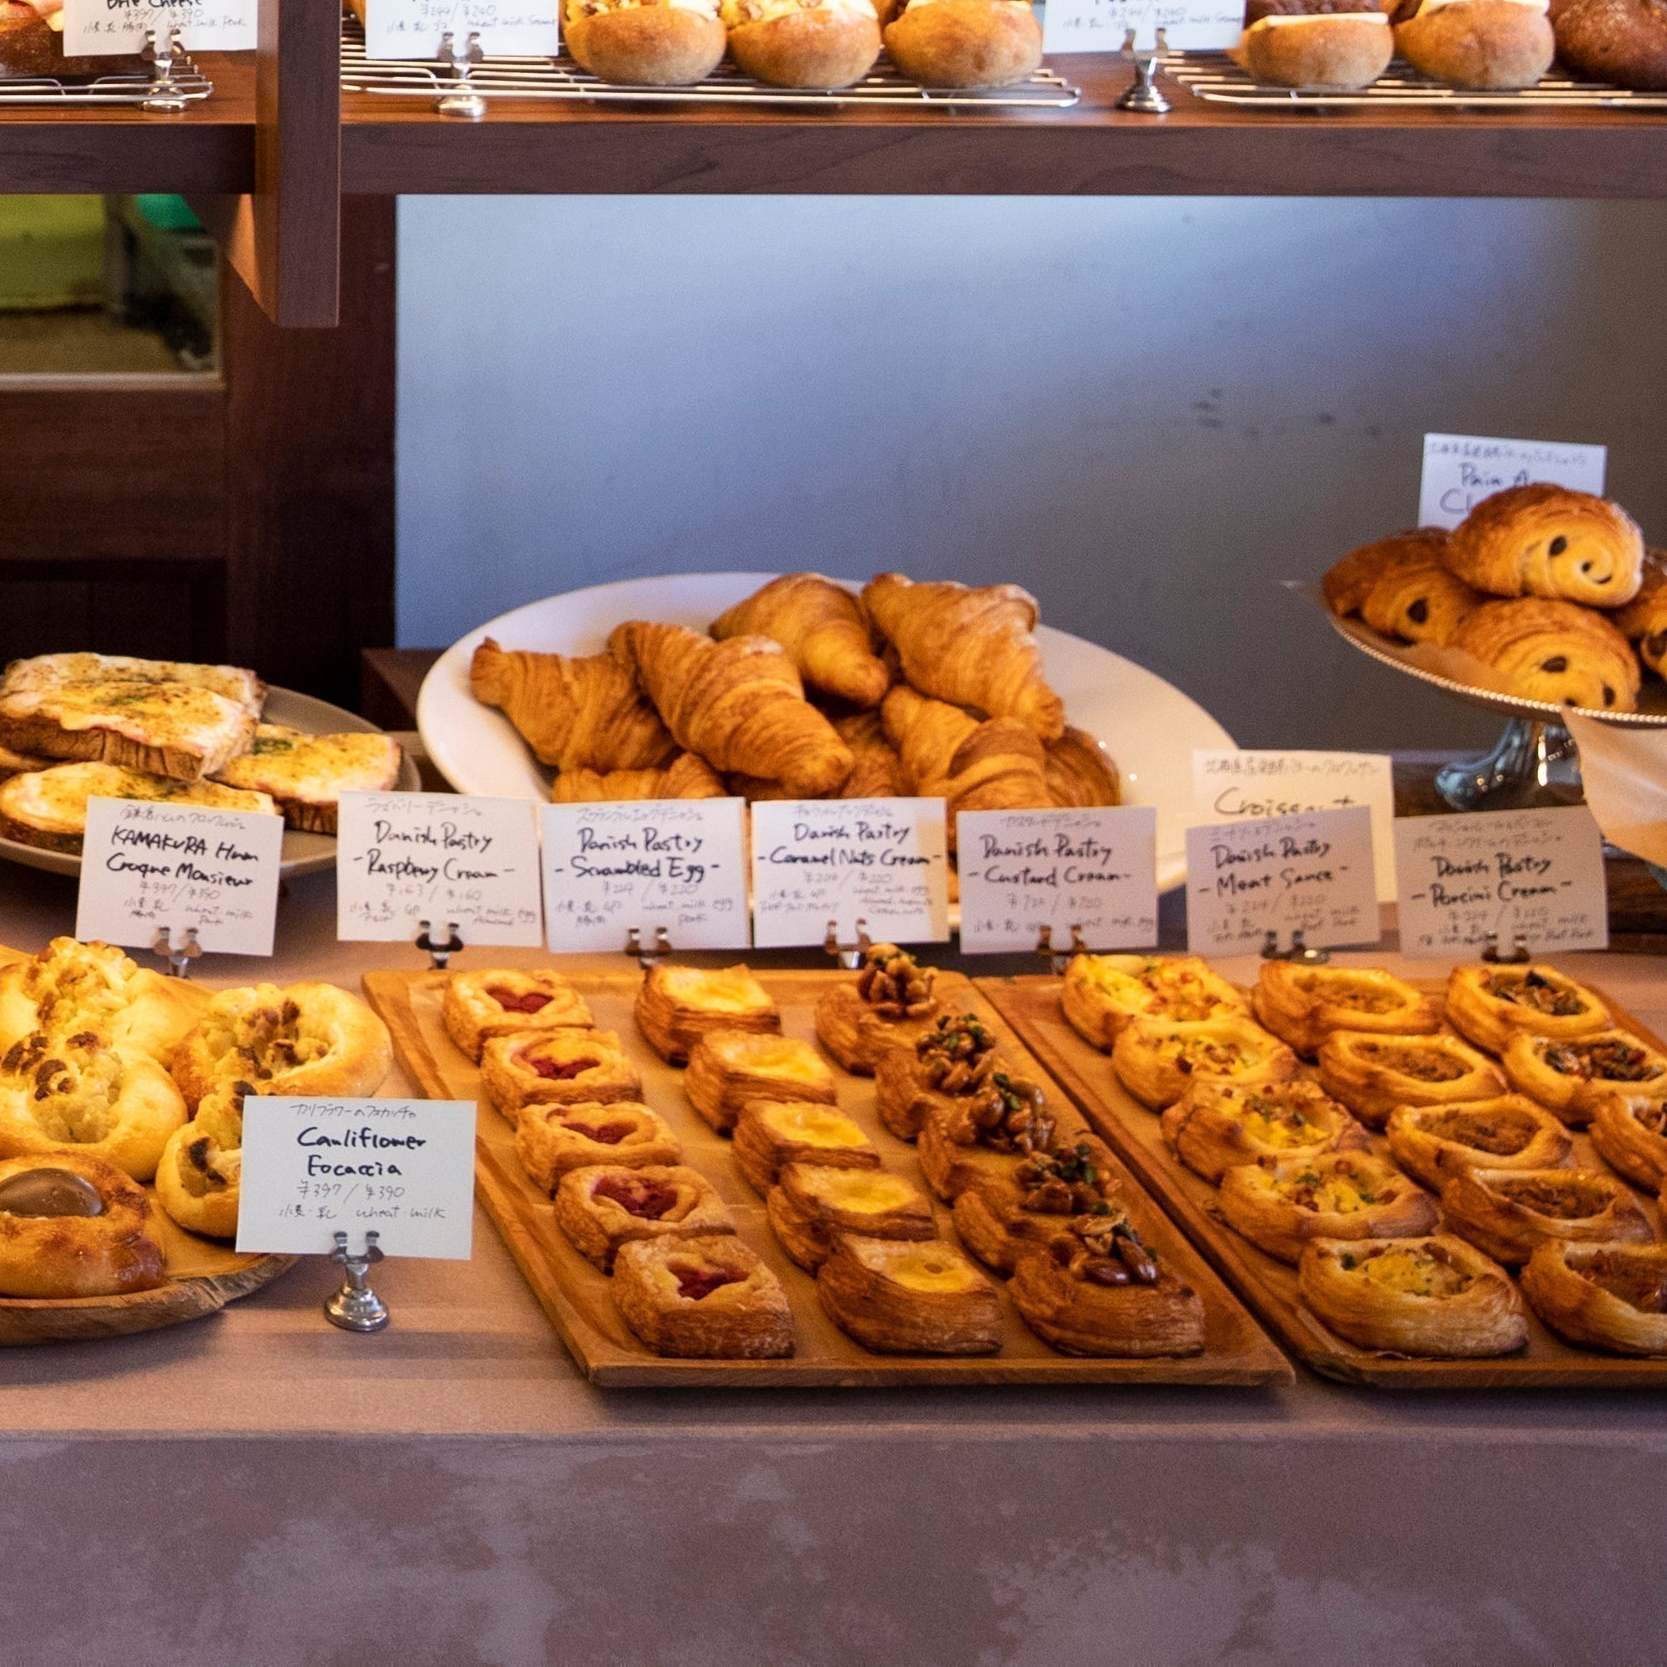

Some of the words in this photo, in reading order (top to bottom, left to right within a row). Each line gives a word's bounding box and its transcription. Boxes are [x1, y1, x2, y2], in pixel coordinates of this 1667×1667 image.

[374, 820, 436, 846] Danish
[440, 821, 492, 853] Pastry
[577, 827, 637, 853] Danish
[643, 827, 703, 853] Pastry
[794, 823, 849, 841] Danish
[856, 821, 910, 844] Pastry
[770, 846, 835, 866] Caramel
[839, 849, 875, 865] Nuts
[880, 849, 930, 866] Cream
[979, 834, 1048, 859] Danish
[1055, 833, 1113, 866] Pastry
[1211, 844, 1275, 868] Danish
[1279, 837, 1331, 858] Pastry
[106, 852, 171, 878] Croque
[175, 862, 253, 887] Monsieur
[443, 858, 498, 881] Cream
[571, 855, 661, 878] Scrambled
[666, 856, 705, 883] Egg
[984, 865, 1058, 887] Custard
[1064, 866, 1120, 883] Cream
[1430, 855, 1489, 878] Danish
[1495, 852, 1552, 878] Pastry
[1217, 872, 1271, 897] Meat
[1280, 867, 1333, 889] Sauce
[1497, 880, 1556, 902] Cream
[297, 1126, 426, 1150] Cauliflower
[307, 1154, 402, 1177] Focaccia
